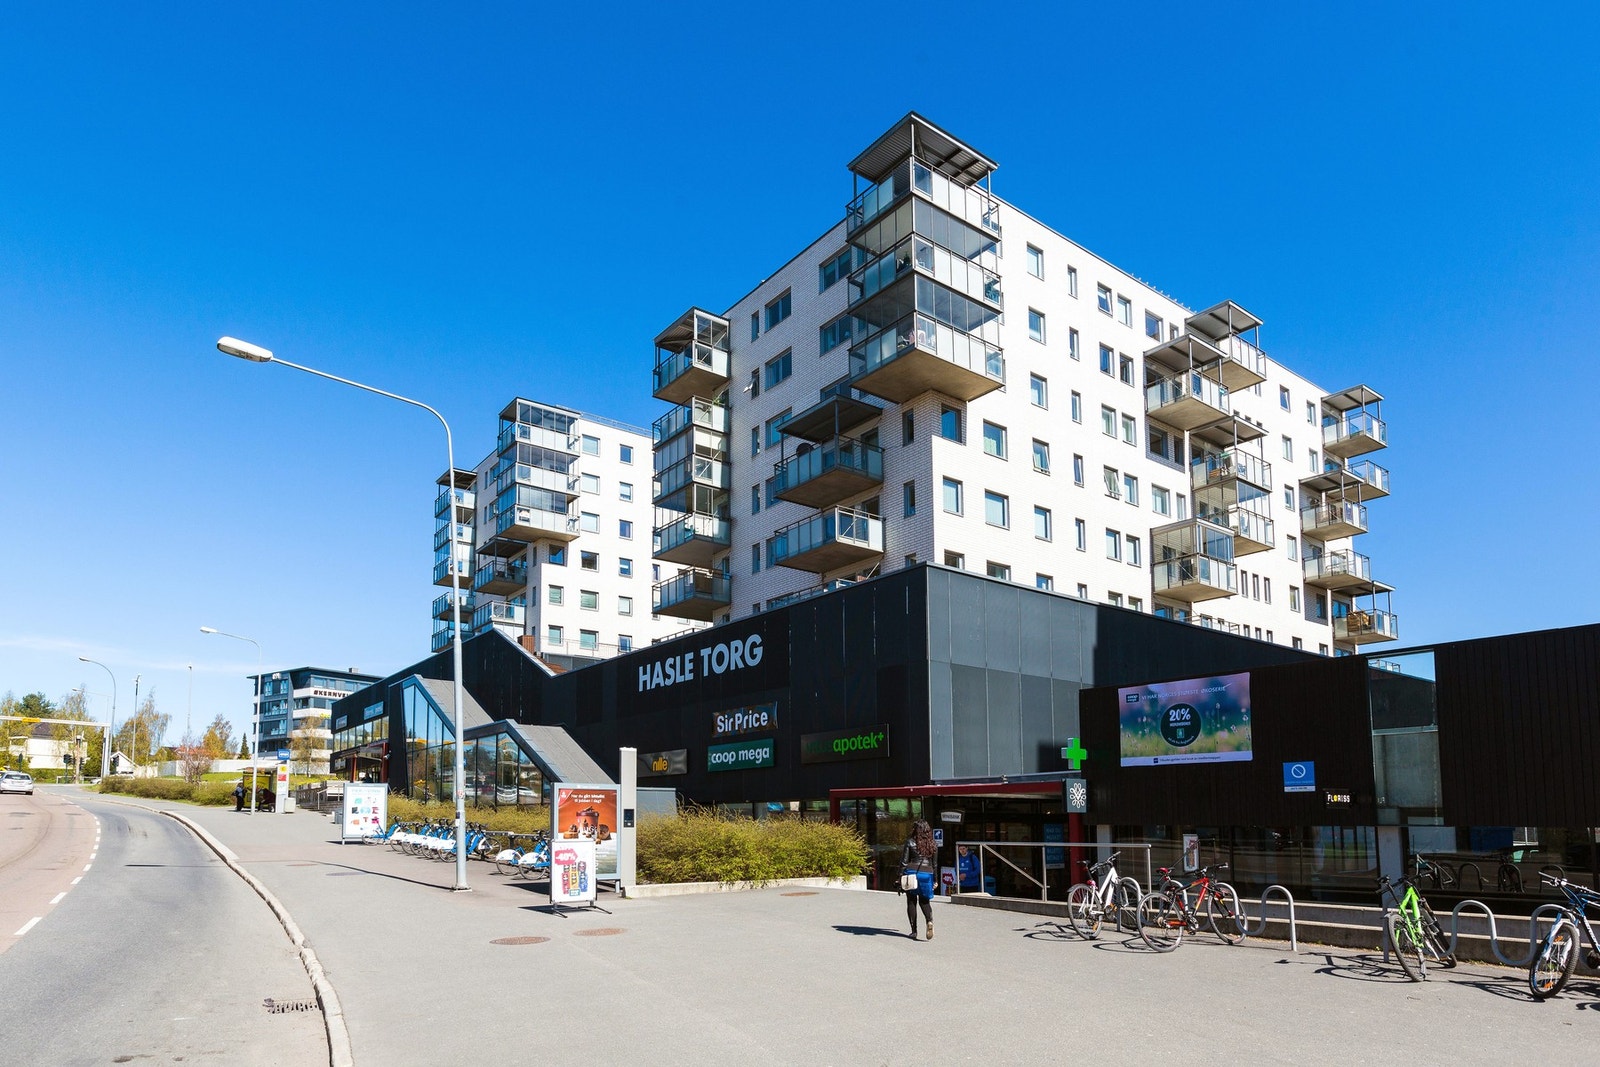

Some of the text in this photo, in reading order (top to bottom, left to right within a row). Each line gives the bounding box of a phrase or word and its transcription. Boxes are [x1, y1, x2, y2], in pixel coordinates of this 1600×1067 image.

[638, 634, 763, 692] HASLE TORG
[1169, 708, 1191, 721] 20%
[711, 747, 770, 764] coop mega
[652, 757, 668, 772] nille
[1327, 794, 1351, 803] FLORISS
